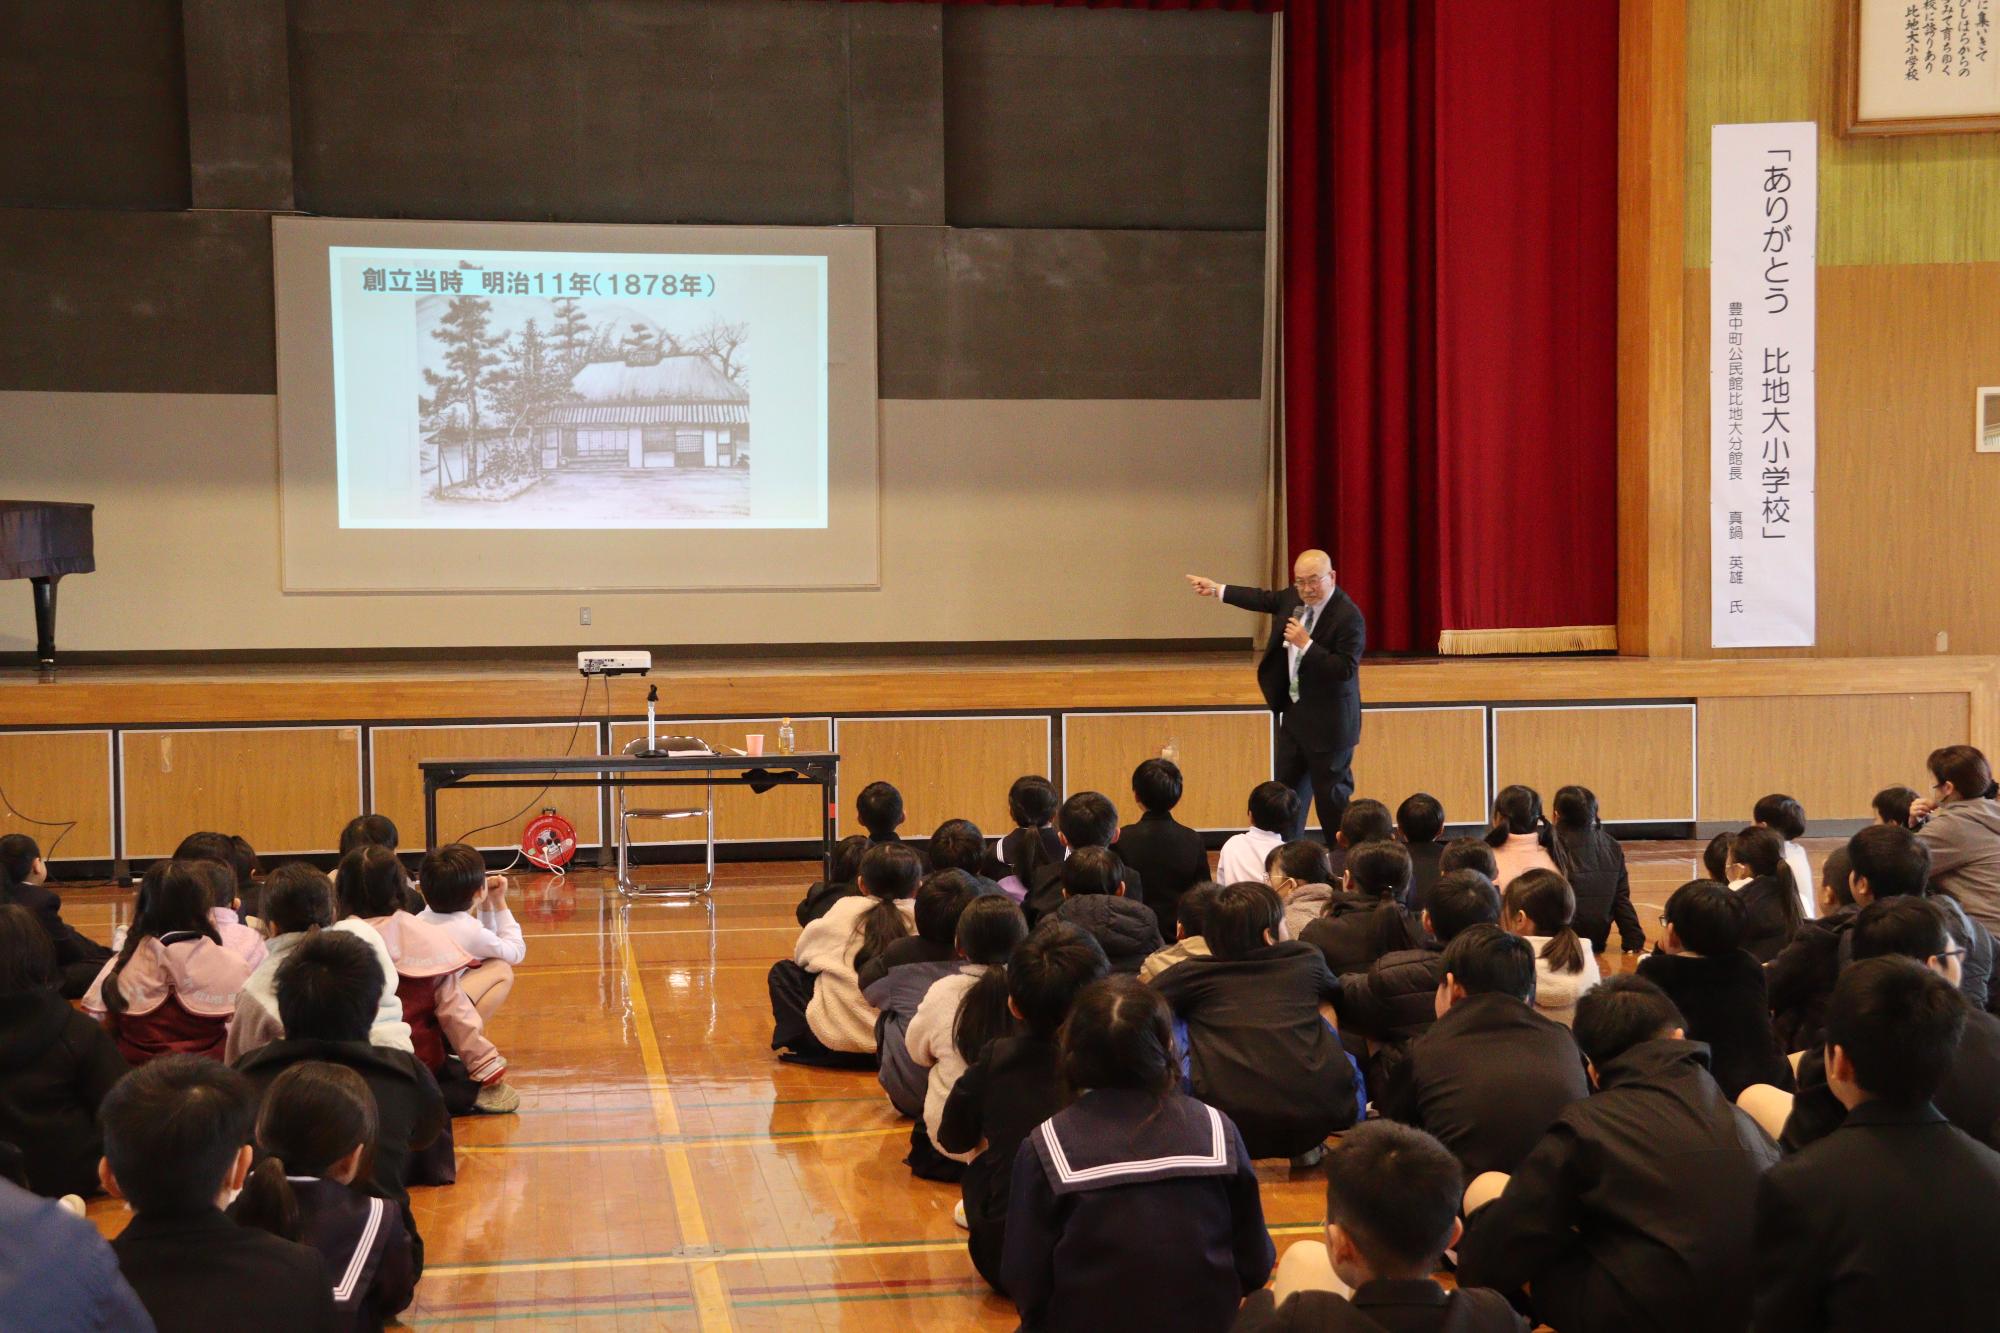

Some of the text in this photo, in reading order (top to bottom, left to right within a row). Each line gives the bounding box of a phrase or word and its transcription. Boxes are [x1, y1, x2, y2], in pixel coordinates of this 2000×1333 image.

[1904, 4, 1919, 81] 比地大小学校
[362, 267, 464, 293] 創立当時
[1761, 149, 1792, 539] 「ありがとう 比地大小学校」
[1728, 301, 1744, 614] 豊中町公民館比地大分館長 真鍋 英雄 氏
